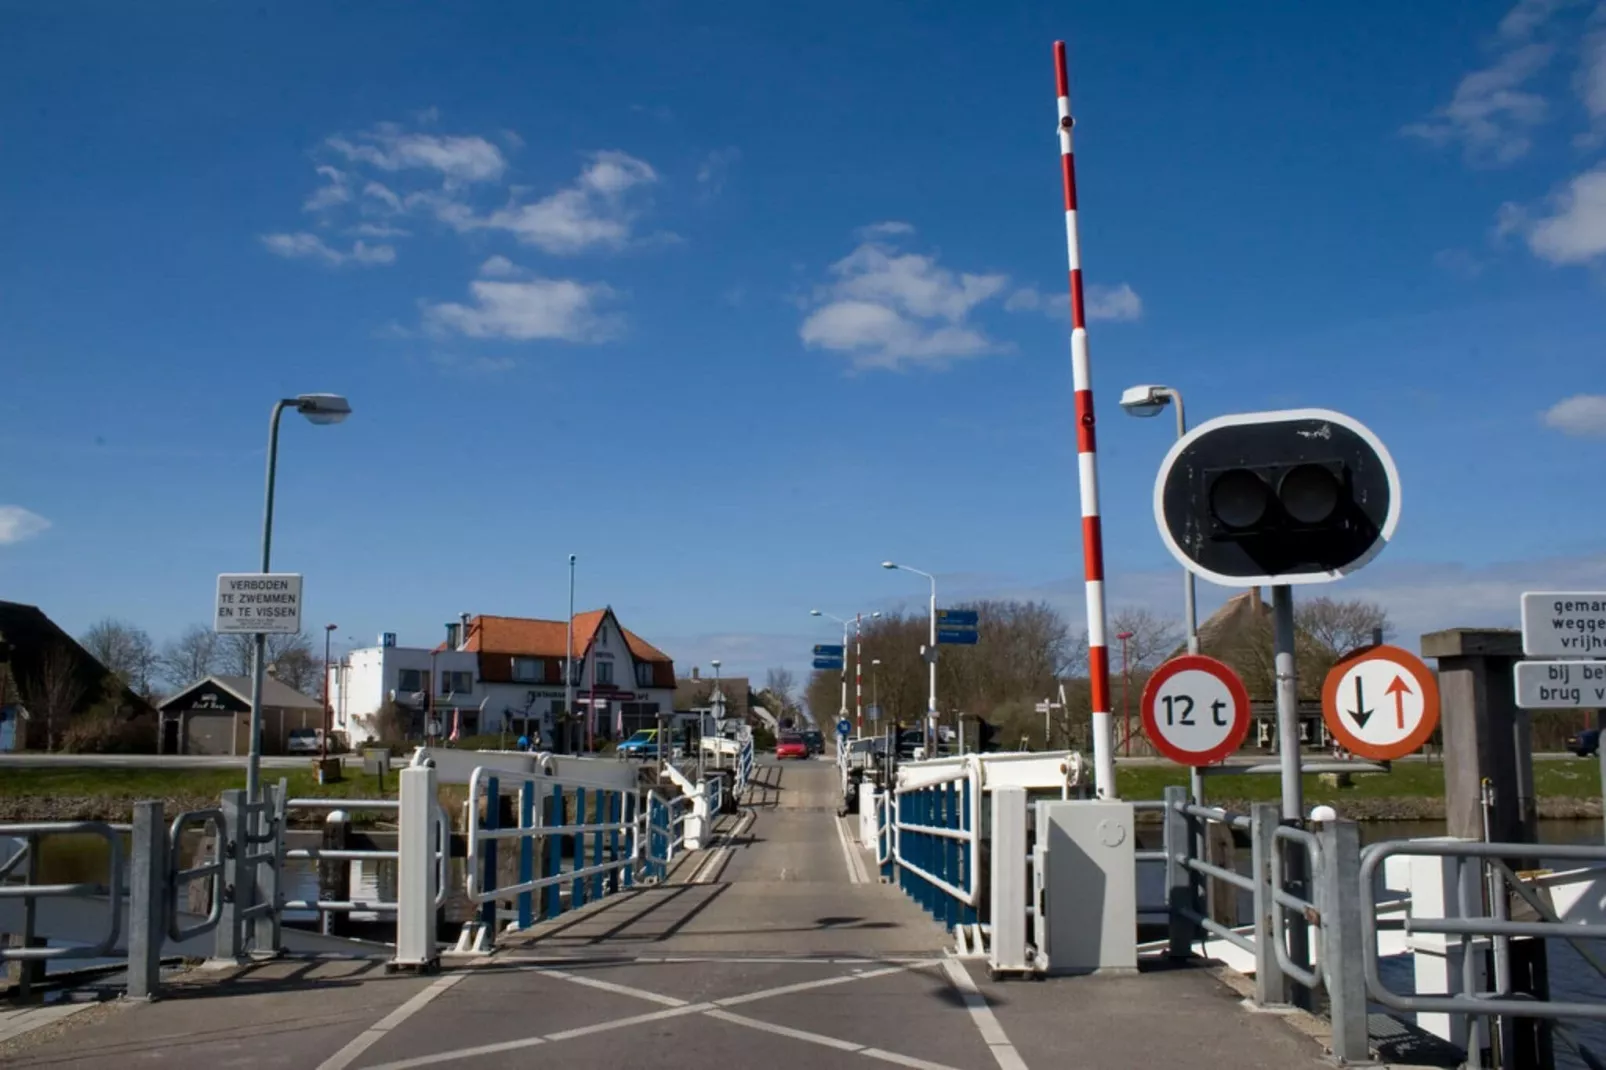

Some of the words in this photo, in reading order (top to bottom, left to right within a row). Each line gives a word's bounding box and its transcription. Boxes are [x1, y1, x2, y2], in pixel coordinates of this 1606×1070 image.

[230, 580, 288, 590] VERBODEN
[221, 594, 234, 604] TE
[240, 593, 296, 604] ZWEMMEN
[218, 607, 233, 617] EN
[238, 607, 251, 617] TE
[256, 607, 296, 617] VISSEN
[1549, 664, 1570, 685] bij
[1583, 665, 1606, 680] be
[1540, 685, 1580, 705] brug
[1162, 695, 1196, 726] 12
[1211, 698, 1228, 726] t
